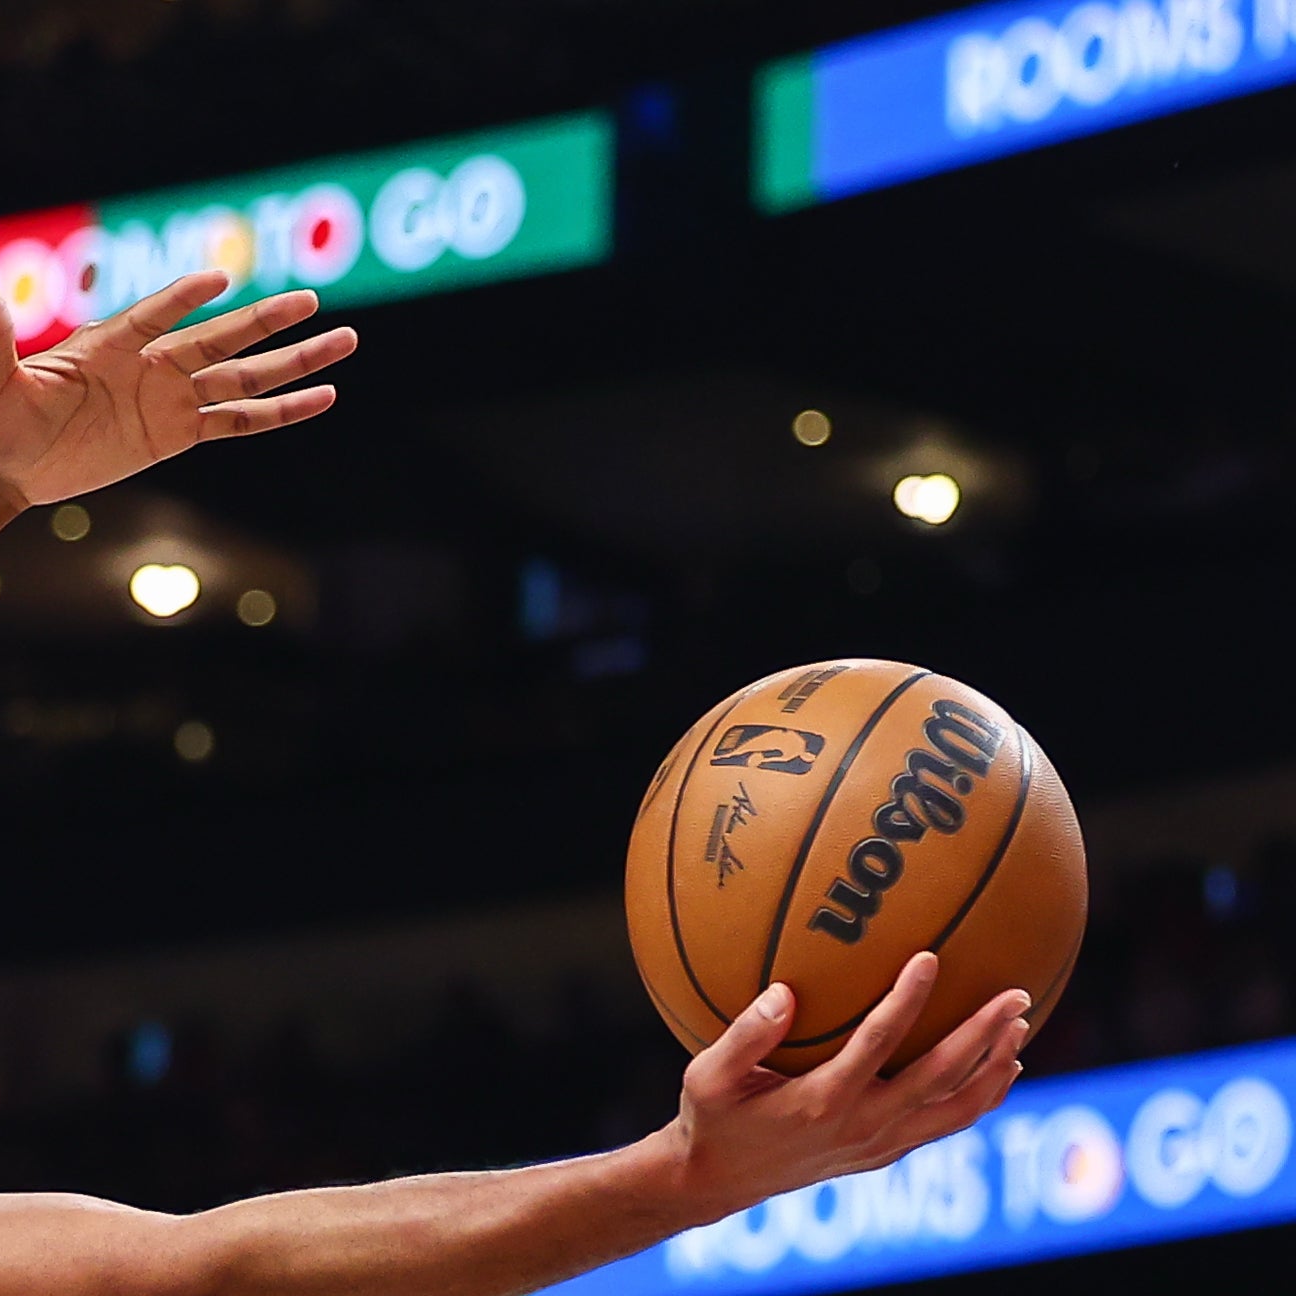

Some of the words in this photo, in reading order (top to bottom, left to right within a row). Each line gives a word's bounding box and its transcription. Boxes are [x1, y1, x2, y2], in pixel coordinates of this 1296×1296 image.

[370, 154, 525, 272] GO
[808, 699, 1006, 944] Wilson
[996, 1104, 1121, 1224] TO
[1128, 1077, 1291, 1207] GO
